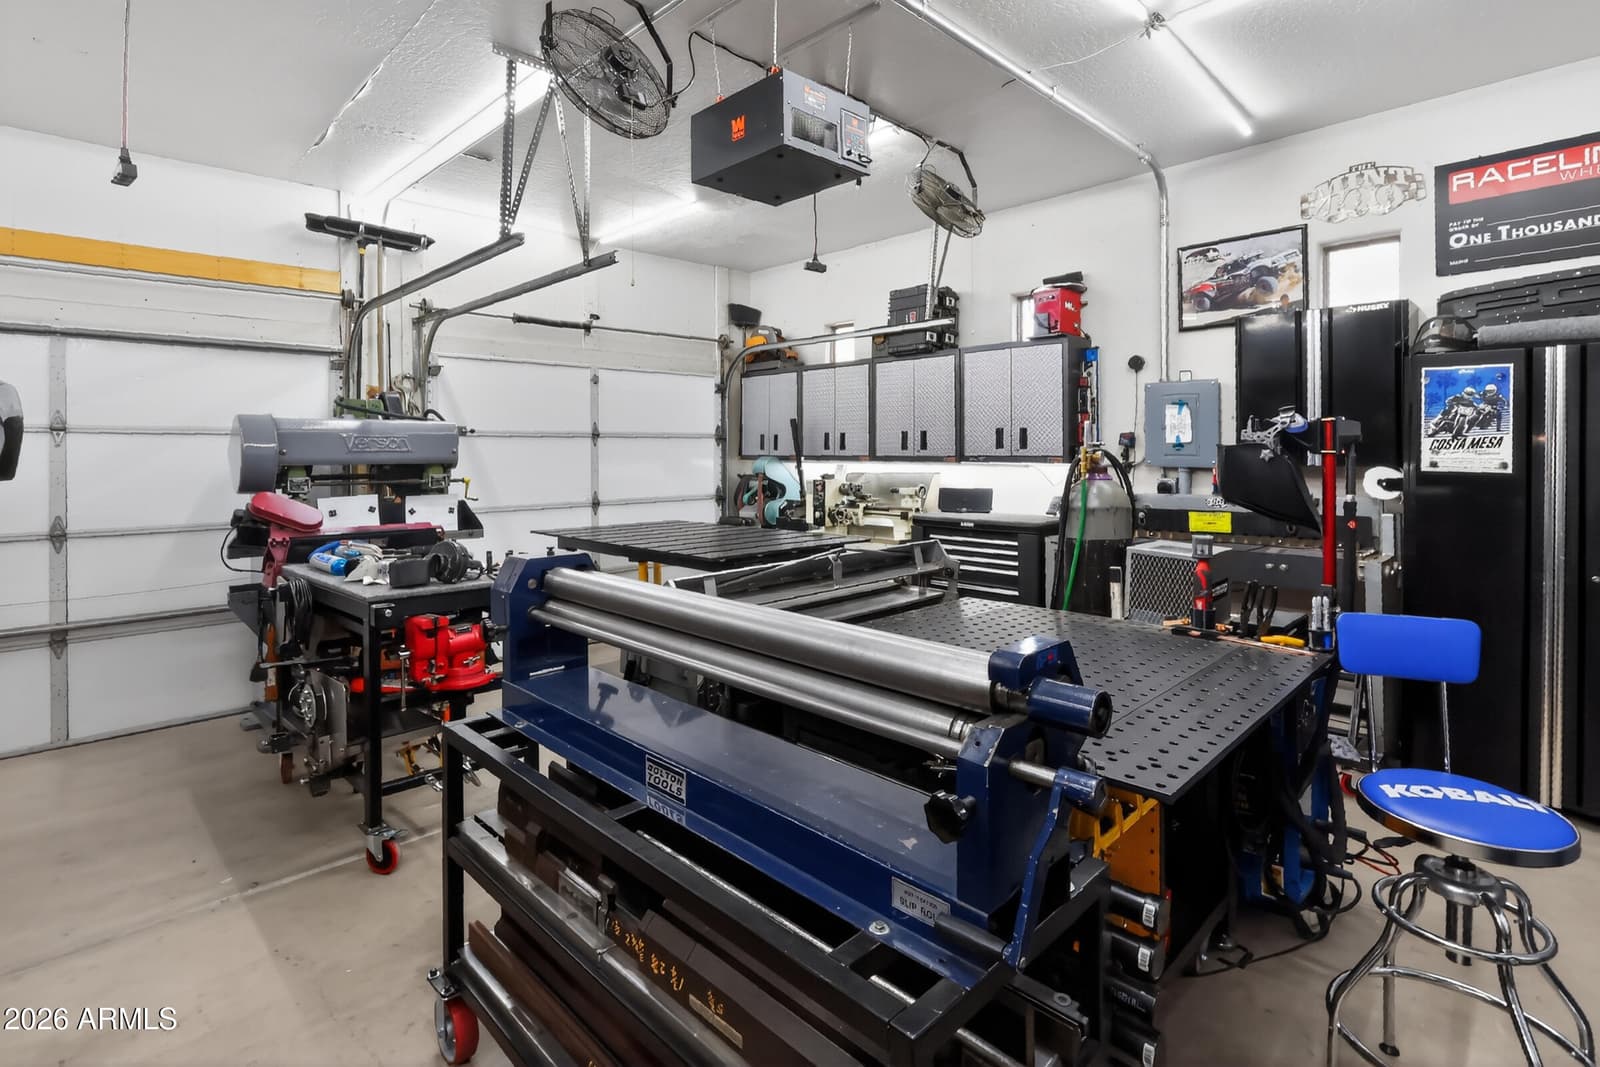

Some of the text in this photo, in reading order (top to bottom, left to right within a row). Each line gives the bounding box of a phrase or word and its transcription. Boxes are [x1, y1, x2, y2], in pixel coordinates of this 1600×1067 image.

[1429, 436, 1504, 451] COSTA MESA
[647, 763, 684, 787] BOLTON
[647, 771, 683, 797] TOOLS
[1378, 783, 1550, 814] KOBALT
